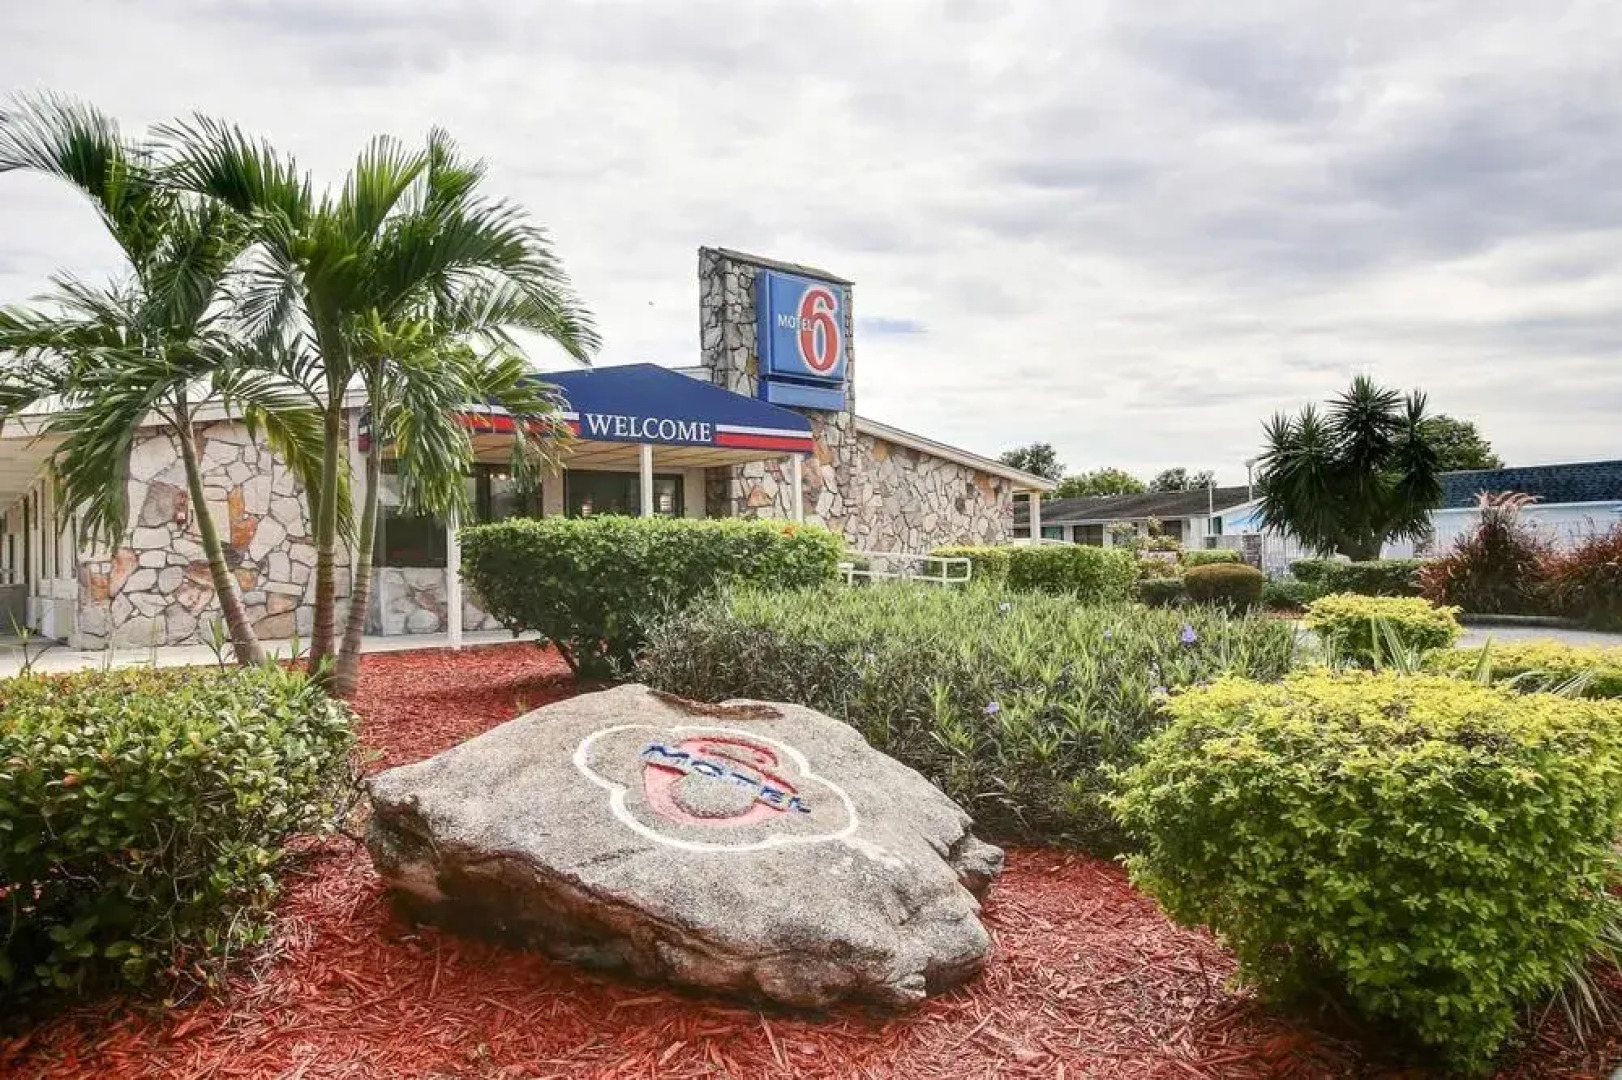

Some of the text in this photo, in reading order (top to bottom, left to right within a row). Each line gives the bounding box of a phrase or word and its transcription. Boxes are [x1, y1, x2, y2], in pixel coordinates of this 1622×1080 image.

[777, 285, 841, 376] MOTEL 6
[584, 413, 712, 442] WELCOME
[640, 743, 811, 814] MOTEL
